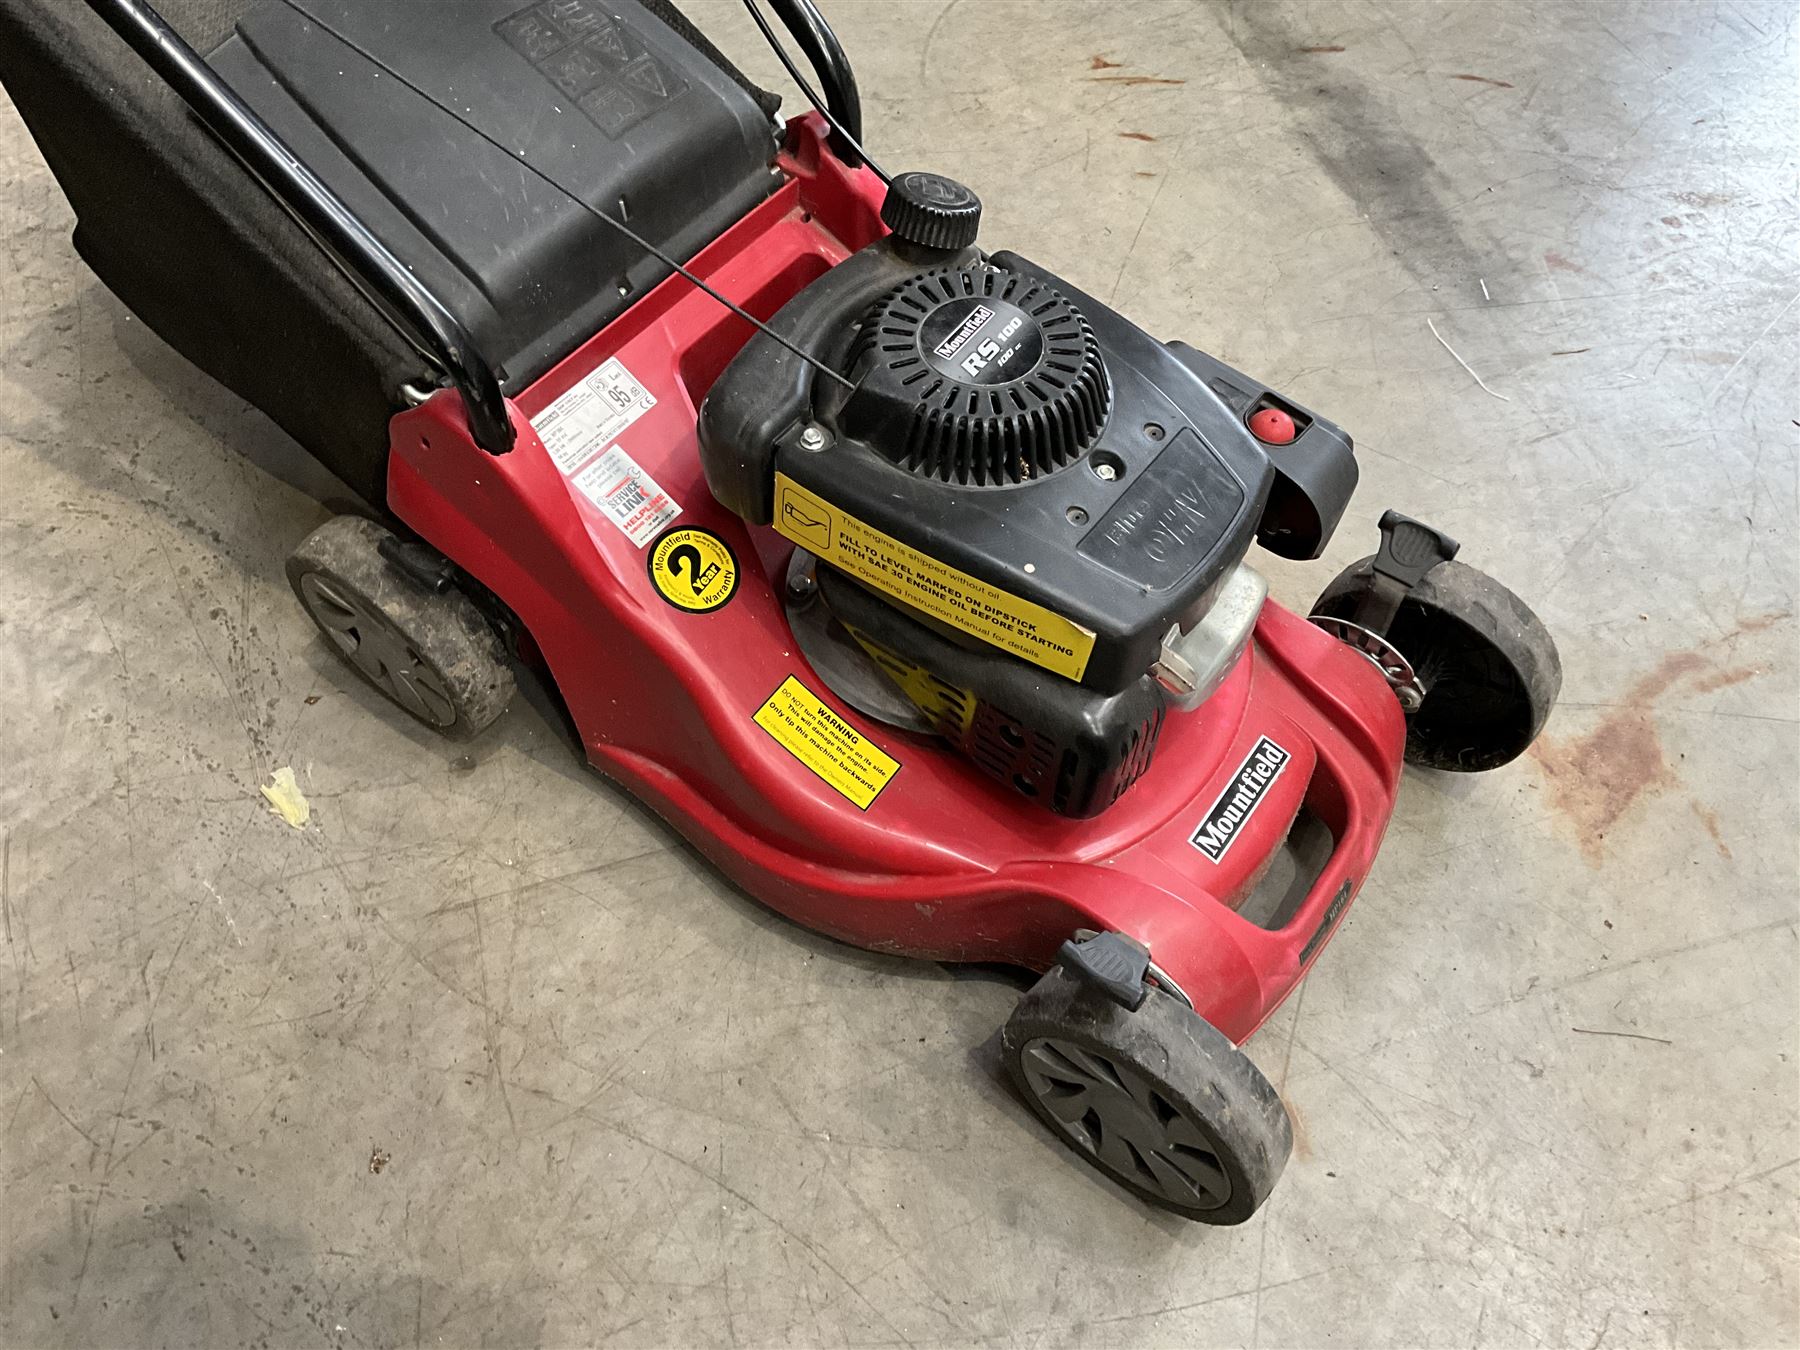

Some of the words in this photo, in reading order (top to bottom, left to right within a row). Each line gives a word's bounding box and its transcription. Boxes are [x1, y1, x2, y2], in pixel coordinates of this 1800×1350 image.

[938, 309, 991, 357] Mountfield
[961, 338, 1000, 377] RS
[998, 317, 1022, 342] 100
[606, 384, 632, 408] 95
[606, 479, 641, 509] SERVICE
[614, 485, 651, 518] LINK
[622, 492, 665, 530] HELPLINE
[656, 533, 690, 571] Mountfield
[668, 544, 721, 596] 2
[693, 565, 717, 589] Year
[841, 515, 860, 531] This
[863, 530, 894, 549] engine
[897, 547, 905, 555] is
[908, 553, 946, 575] shipped
[949, 573, 984, 593] without
[703, 570, 733, 604] Warranty
[838, 555, 855, 568] See
[858, 566, 901, 594] Operating
[904, 590, 951, 618] Instruction
[954, 615, 989, 635] Manual
[992, 632, 1004, 642] for
[1007, 641, 1038, 657] details
[839, 532, 860, 548] FILL
[863, 545, 877, 556] TO
[880, 554, 912, 575] LEVEL
[916, 572, 961, 598] MARKED
[965, 596, 980, 607] ON
[984, 604, 1036, 631] DIPSTICK
[839, 541, 864, 559] WITH
[868, 556, 887, 571] SAE
[891, 569, 902, 579] 30
[906, 576, 945, 600] ENGINE
[949, 598, 966, 610] OIL
[970, 607, 1013, 631] BEFORE
[1017, 624, 1072, 656] STARTING
[769, 702, 784, 717] Only
[785, 716, 794, 726] tip
[795, 725, 808, 738] this
[809, 738, 837, 762] machine
[838, 761, 875, 791] backwards
[781, 688, 791, 697] DO
[791, 696, 804, 708] NOT
[803, 708, 816, 720] turn
[817, 719, 828, 731] this
[828, 730, 853, 751] machine
[854, 751, 863, 759] on
[863, 757, 871, 765] its
[872, 765, 886, 777] side.
[787, 703, 799, 717] This
[800, 716, 812, 726] will
[811, 726, 834, 746] damage
[835, 745, 845, 755] the
[846, 755, 867, 771] engine.
[817, 707, 858, 744] WARNING
[1196, 742, 1283, 856] Mountfield
